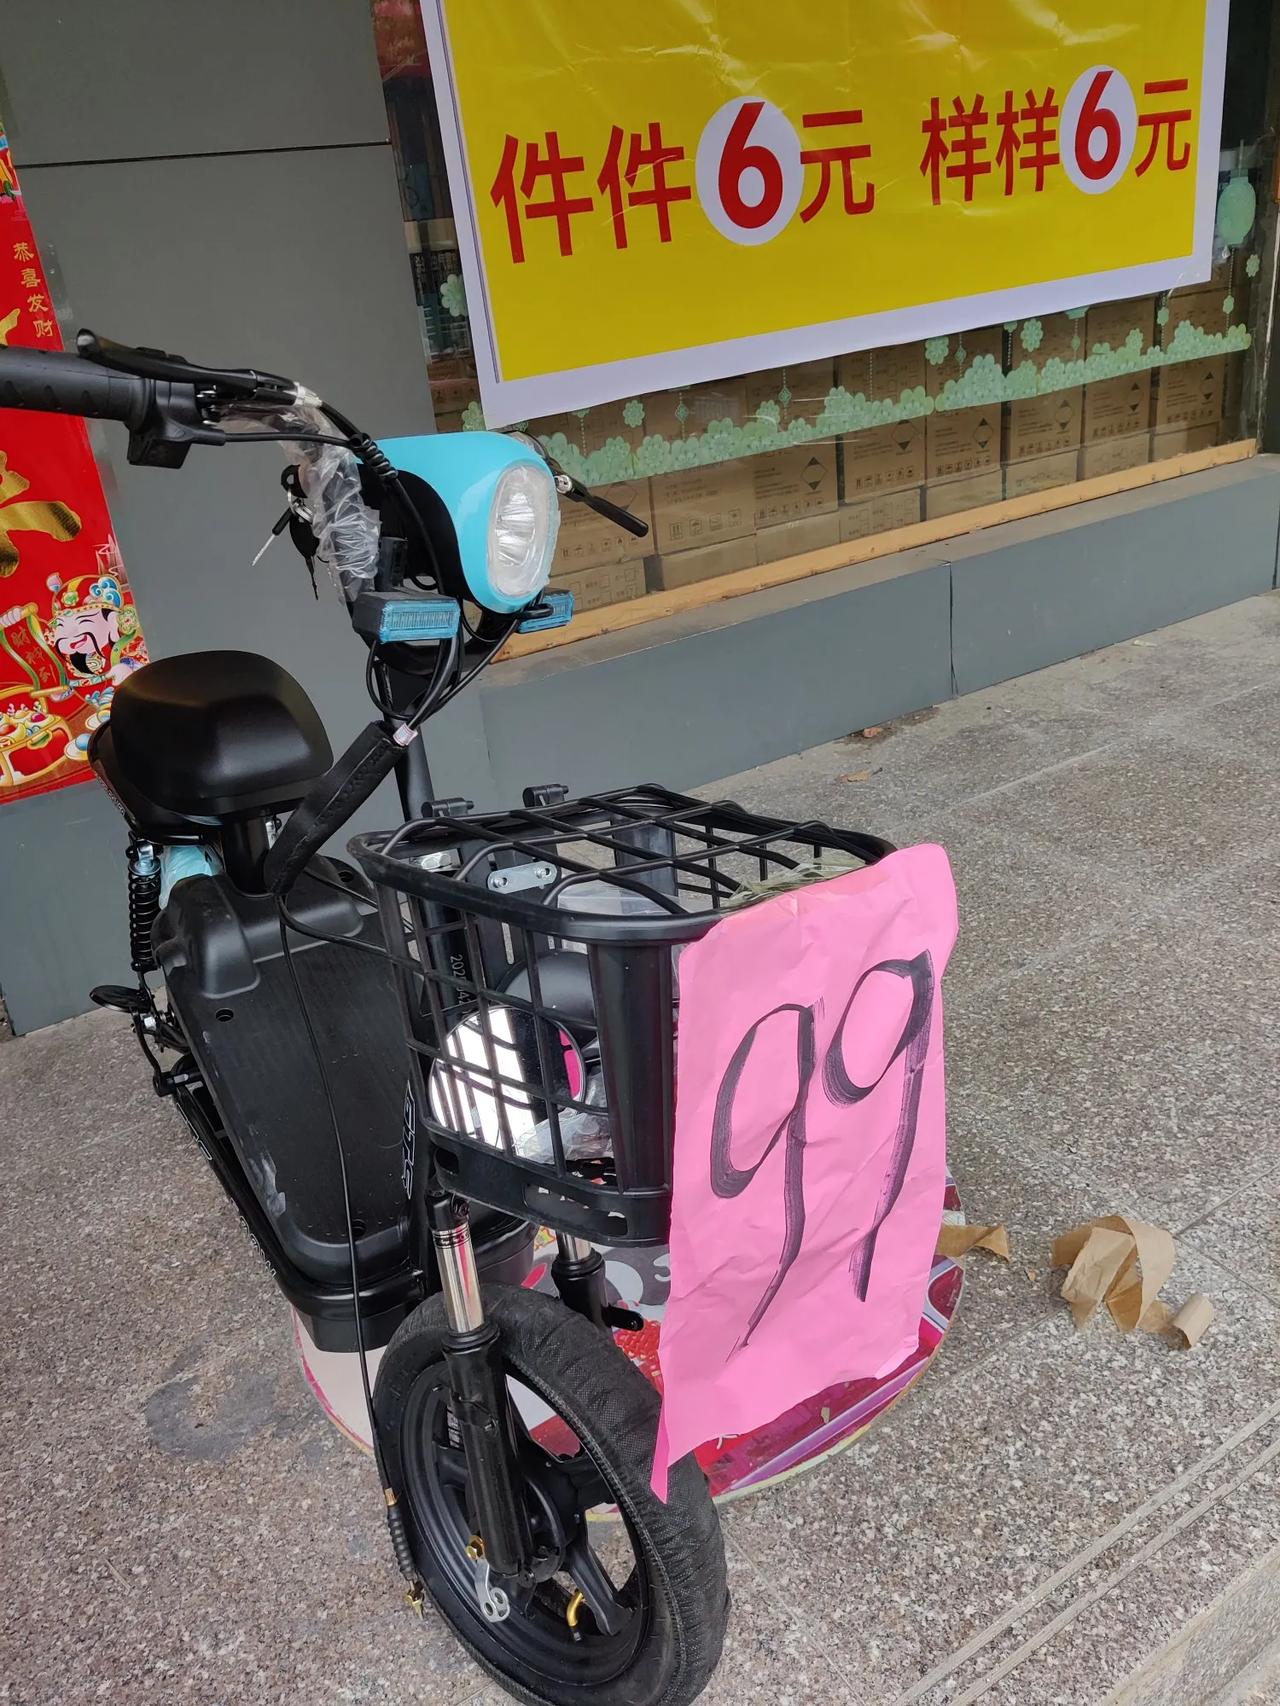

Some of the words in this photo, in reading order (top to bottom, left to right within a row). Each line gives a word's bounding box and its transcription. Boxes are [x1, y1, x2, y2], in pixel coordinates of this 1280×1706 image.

[490, 100, 875, 263] 件件6元
[919, 69, 1191, 206] 样样6元
[13, 242, 54, 338] 恭喜发财
[710, 949, 934, 1362] 99
